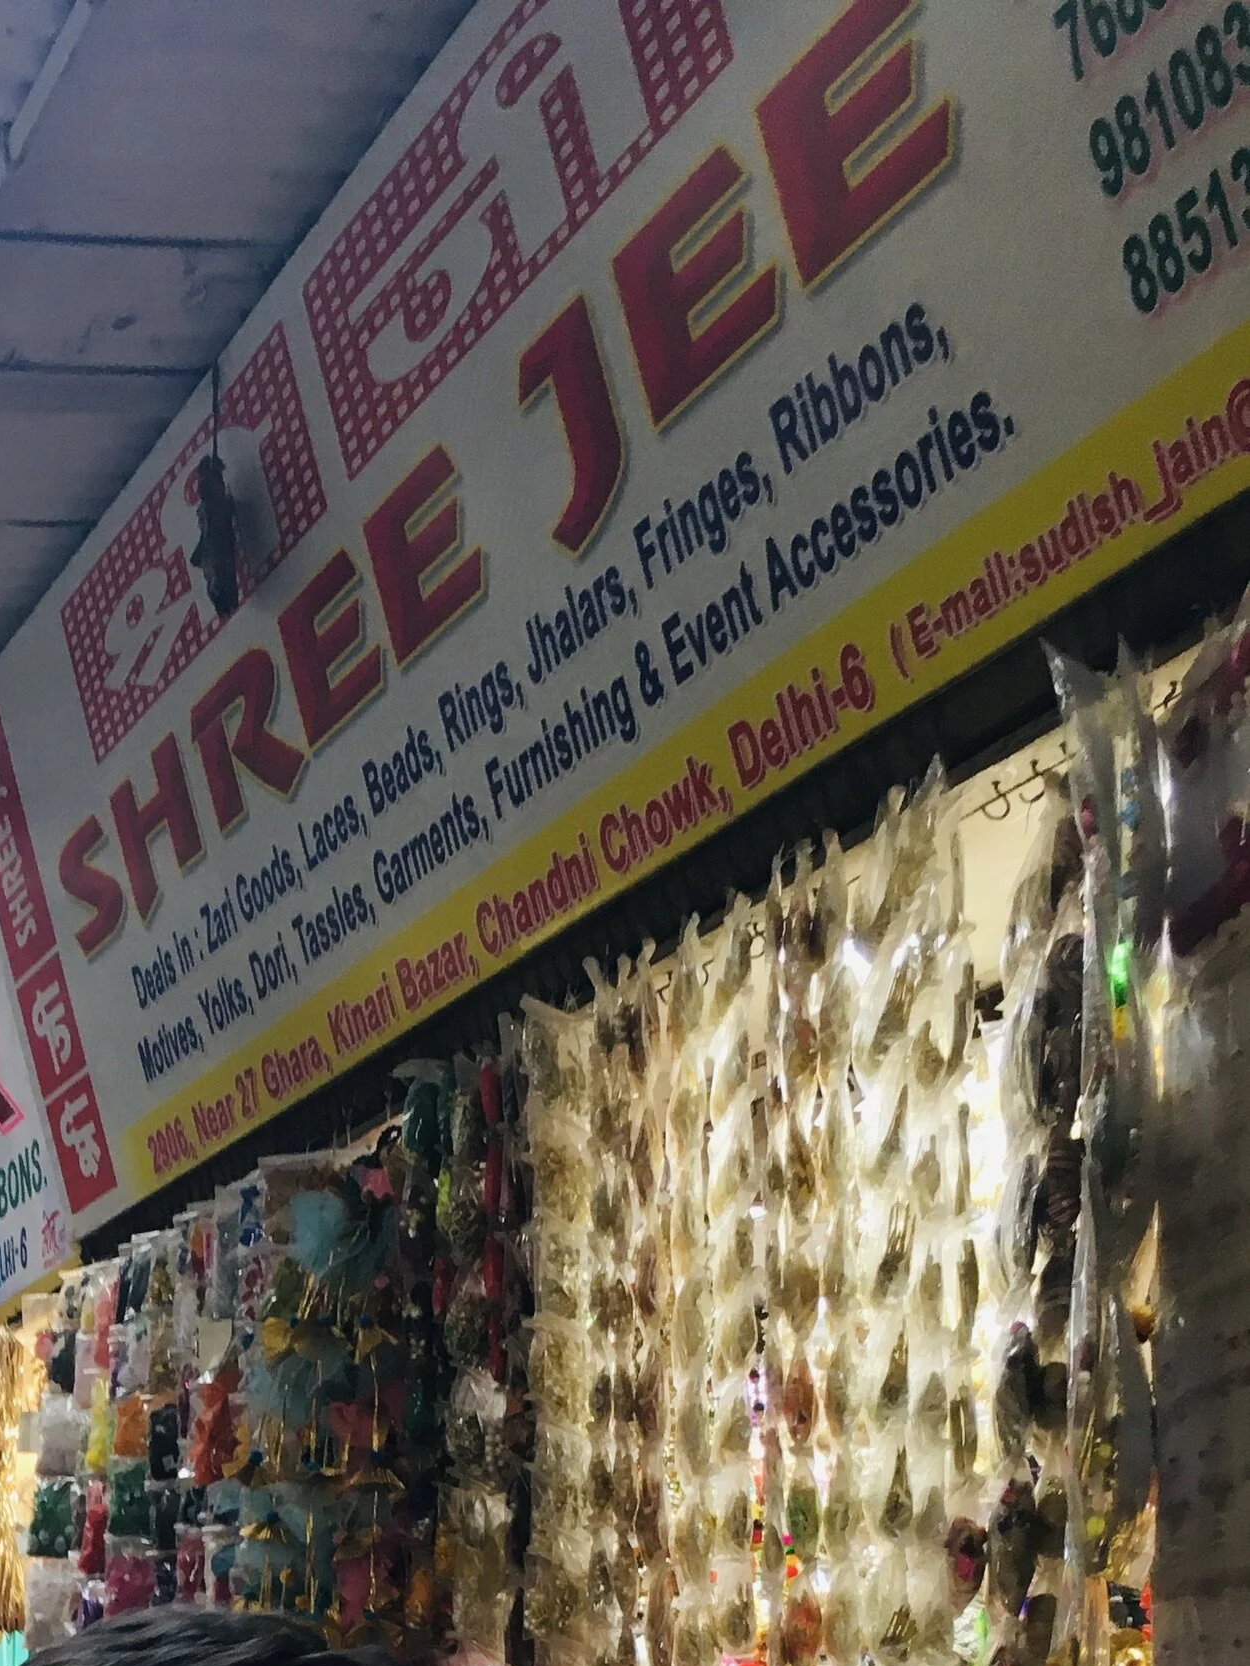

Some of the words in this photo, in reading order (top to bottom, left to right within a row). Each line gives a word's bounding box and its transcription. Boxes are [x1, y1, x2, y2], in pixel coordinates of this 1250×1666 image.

[58, 442, 485, 960] SHREE
[518, 0, 956, 557] JEE
[131, 943, 177, 1009] Deals
[175, 931, 196, 977] In
[200, 886, 236, 954] Zari
[236, 844, 304, 922] Goods,
[297, 796, 370, 872] Laces,
[361, 725, 445, 819] Beads,
[438, 659, 524, 754] Rings,
[525, 566, 639, 685] Jhalars,
[632, 450, 774, 590] Fringes,
[768, 302, 950, 475] Ribbons,
[137, 1014, 204, 1083] Motives,
[198, 974, 253, 1037] Yolks,
[248, 931, 299, 1002] Dori,
[291, 880, 377, 958] Tassles,
[371, 792, 490, 906] Garments,
[484, 676, 638, 819] Furnishing
[634, 640, 665, 707] &
[660, 560, 764, 687] Event
[765, 391, 1015, 611] Accessories.
[191, 1093, 235, 1147] Near
[234, 1066, 259, 1119] 27
[261, 1034, 332, 1099] Ghara,
[327, 972, 398, 1057] Kinari
[395, 930, 480, 1013] Bazar,
[474, 832, 600, 958] Chandni
[600, 755, 734, 874] Chowk,
[727, 642, 875, 790] Delhi-6
